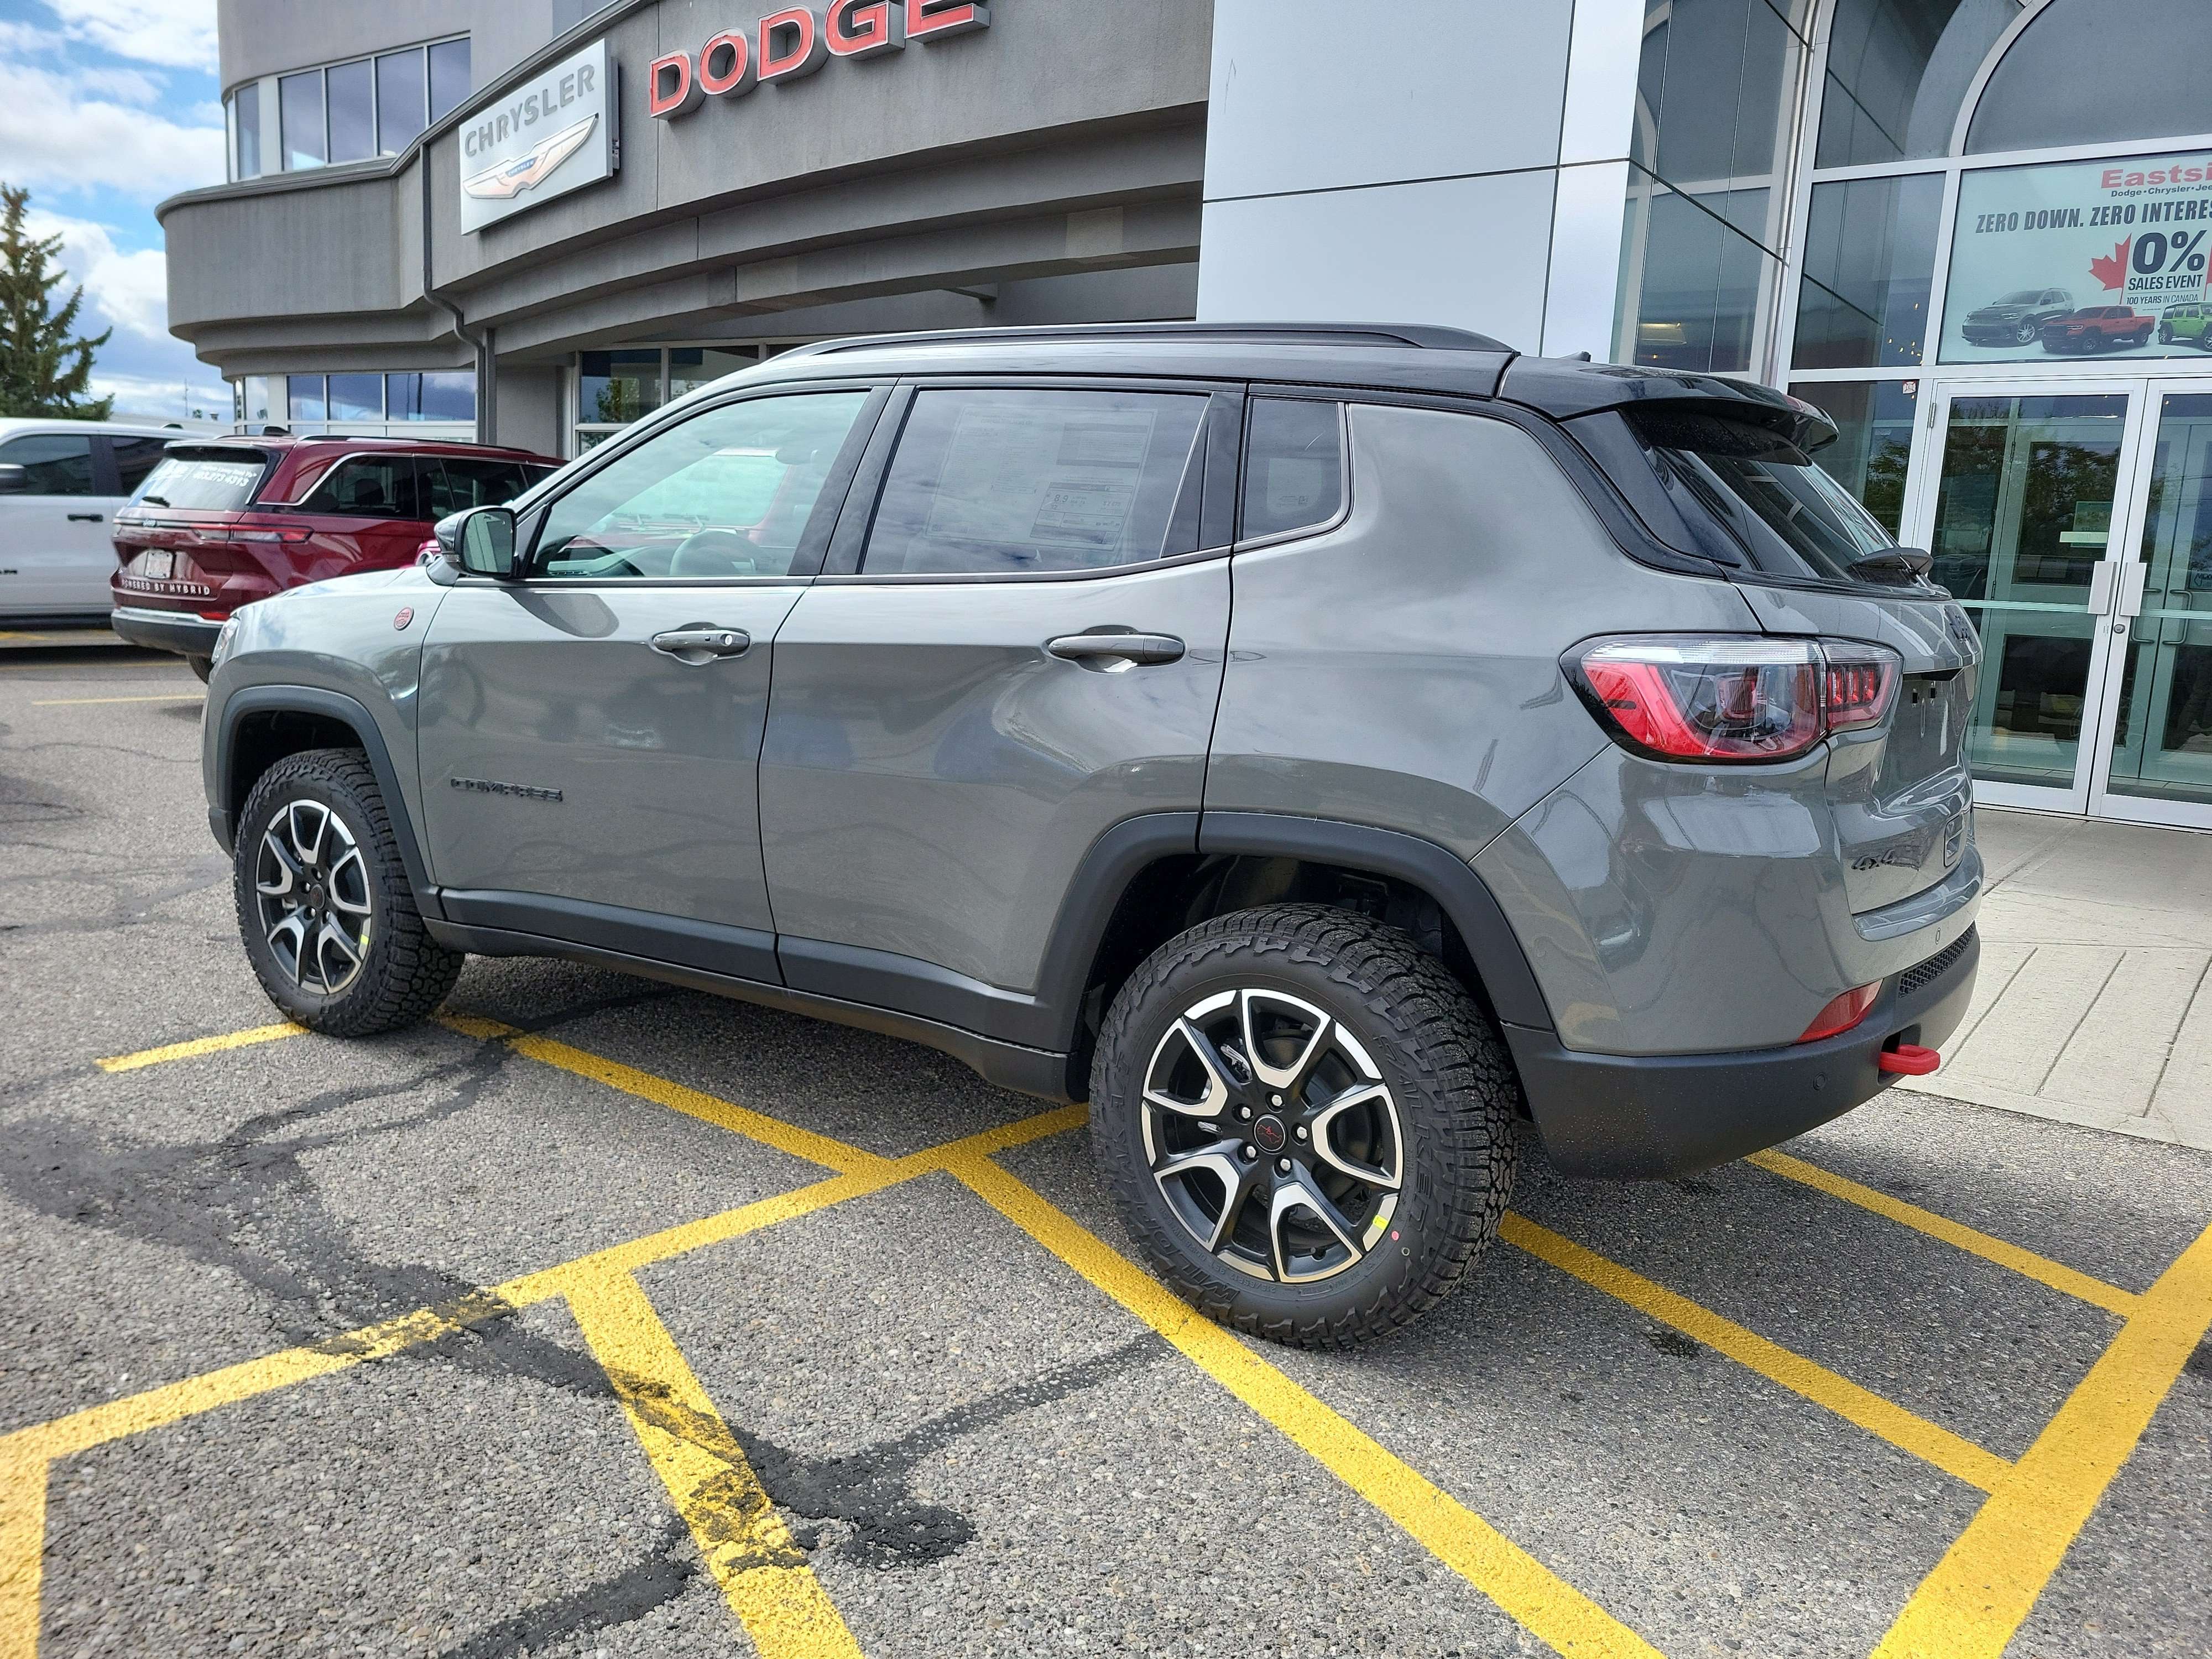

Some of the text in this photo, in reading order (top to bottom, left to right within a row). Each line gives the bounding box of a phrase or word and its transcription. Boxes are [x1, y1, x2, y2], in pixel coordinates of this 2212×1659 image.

[650, 0, 977, 118] DODGE
[465, 64, 594, 157] CHRYSLER
[2148, 186, 2190, 195] Chrysler
[1975, 212, 2018, 233] ZERO
[2024, 208, 2084, 230] DOWN.
[2089, 204, 2136, 227] ZERO
[2132, 230, 2207, 274] 0%
[2128, 274, 2203, 290] SALES EVENT
[2140, 295, 2162, 304] YEARS
[2171, 294, 2198, 303] CANADA
[169, 583, 210, 596] HYBRID
